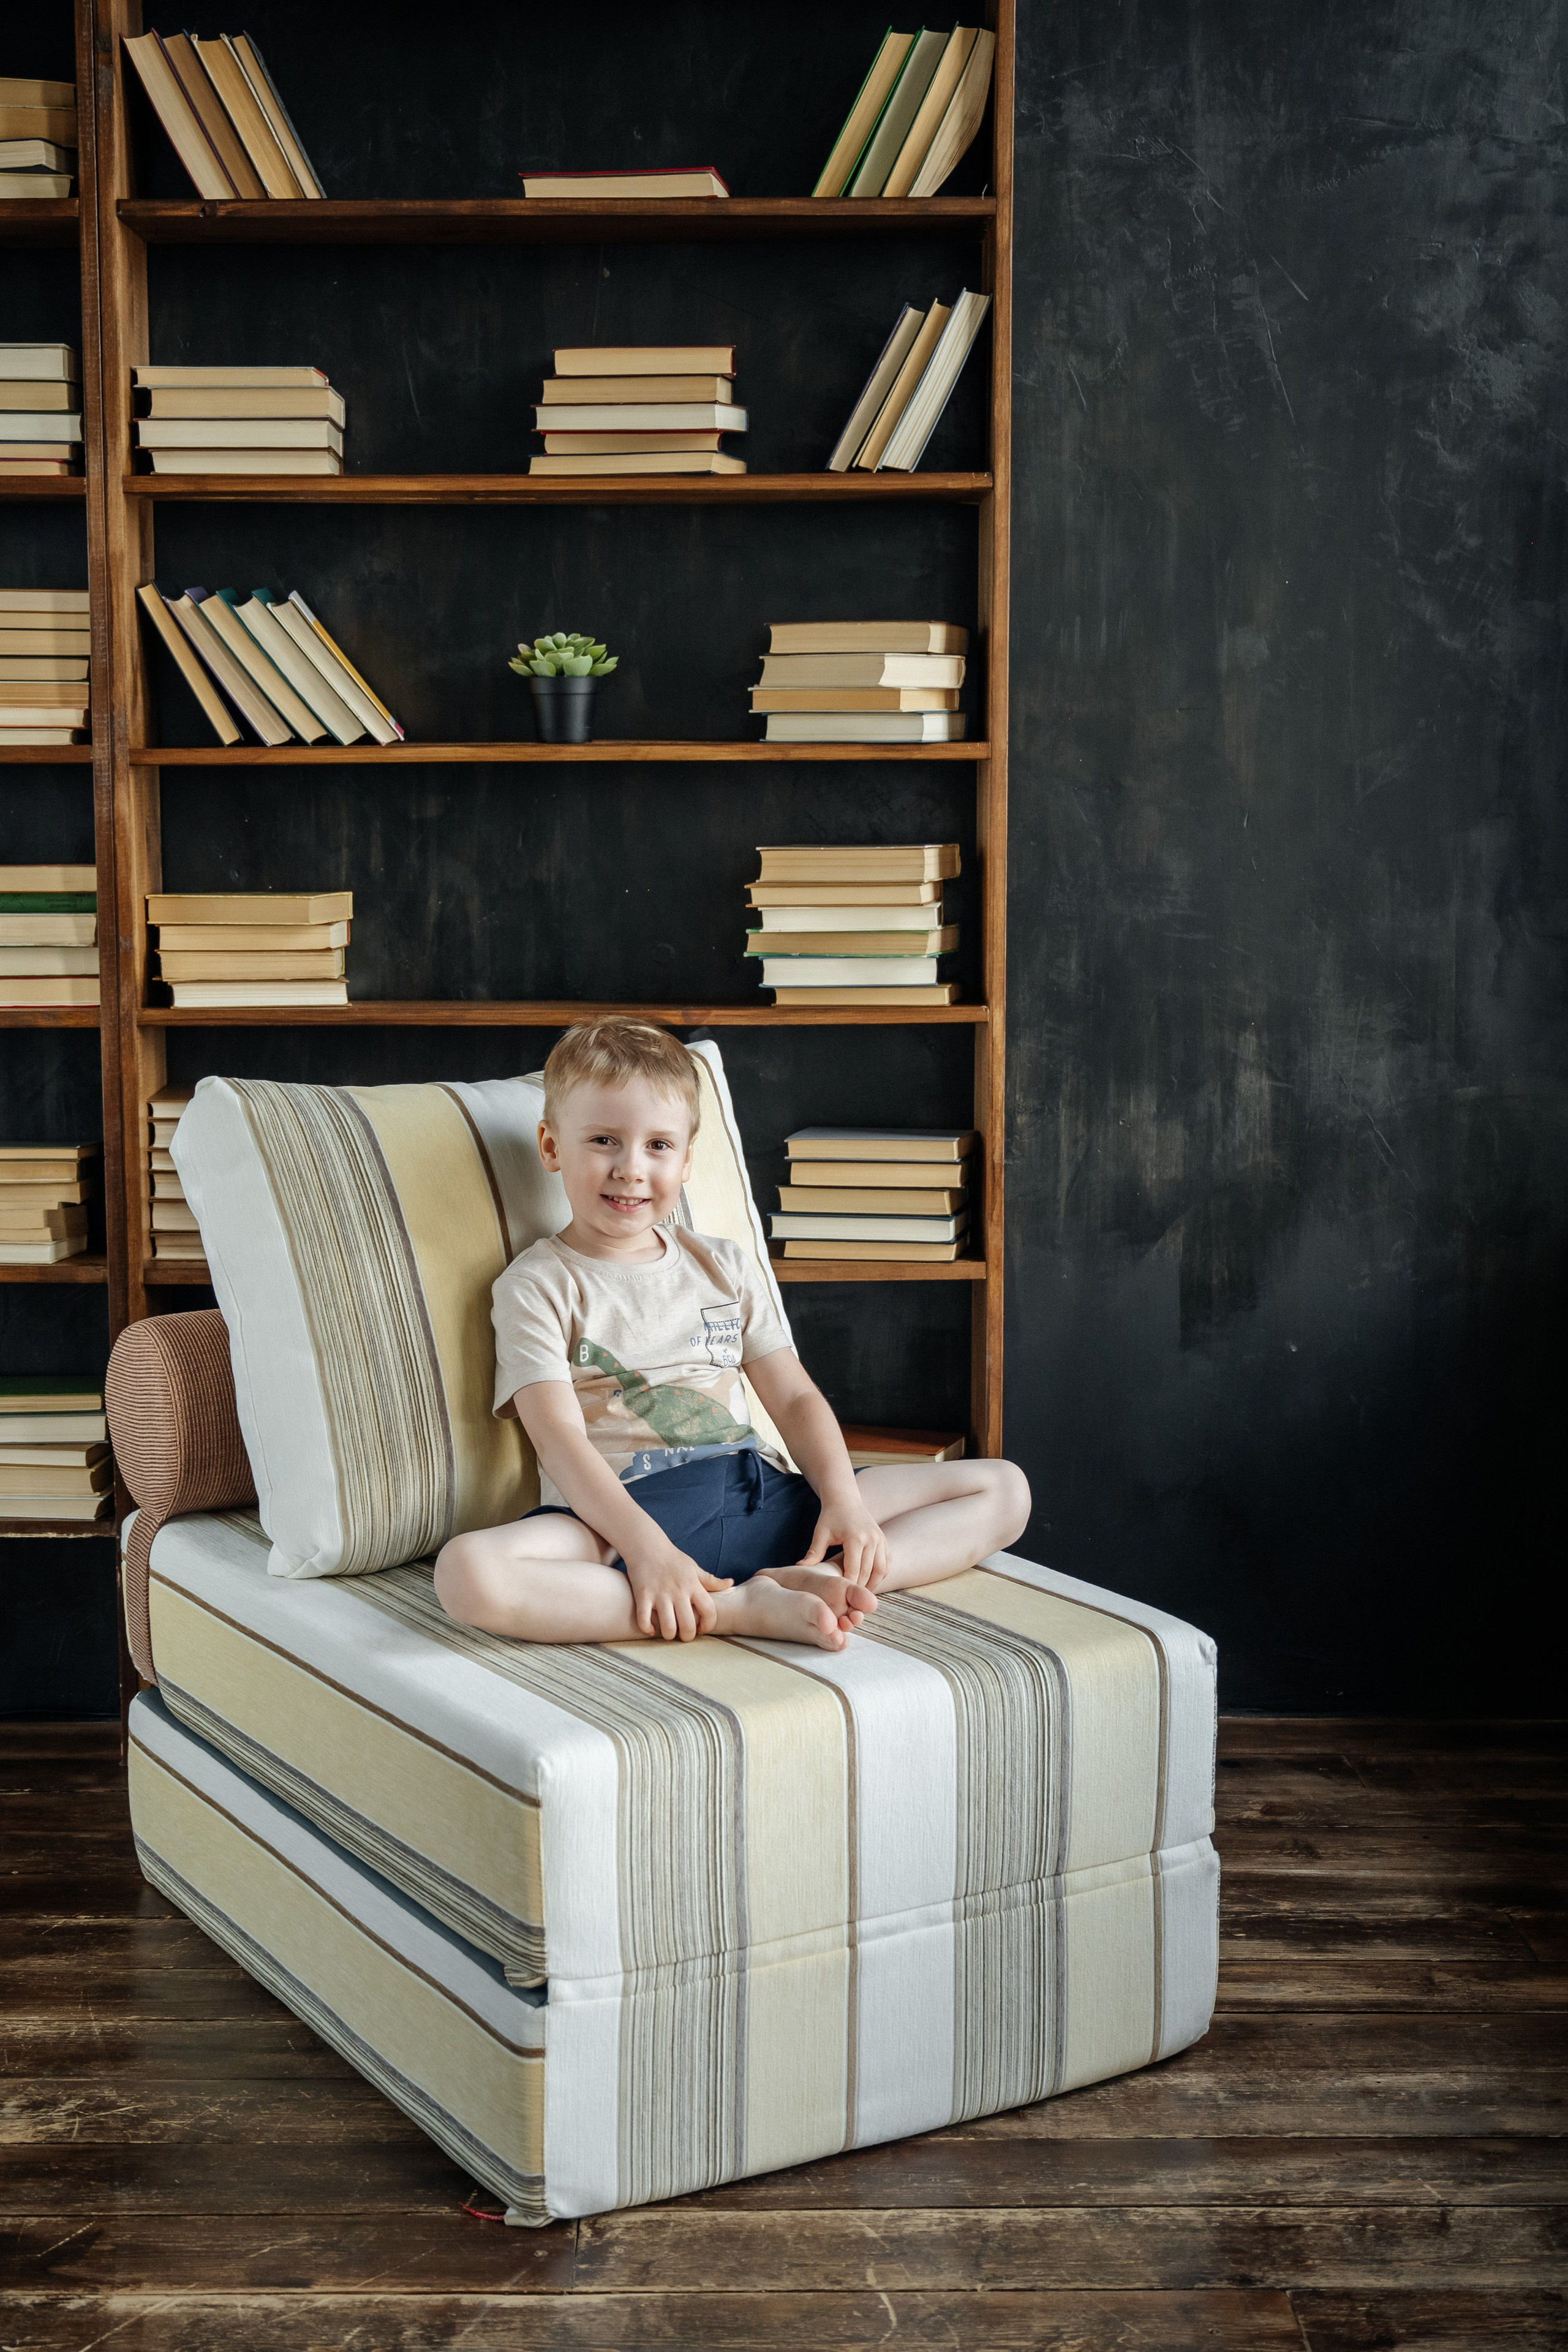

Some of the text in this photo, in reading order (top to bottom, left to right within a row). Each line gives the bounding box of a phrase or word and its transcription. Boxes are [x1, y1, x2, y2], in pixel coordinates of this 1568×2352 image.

[690, 1334, 738, 1347] OF YEARS
[579, 1344, 589, 1363] B
[642, 1453, 652, 1471] S
